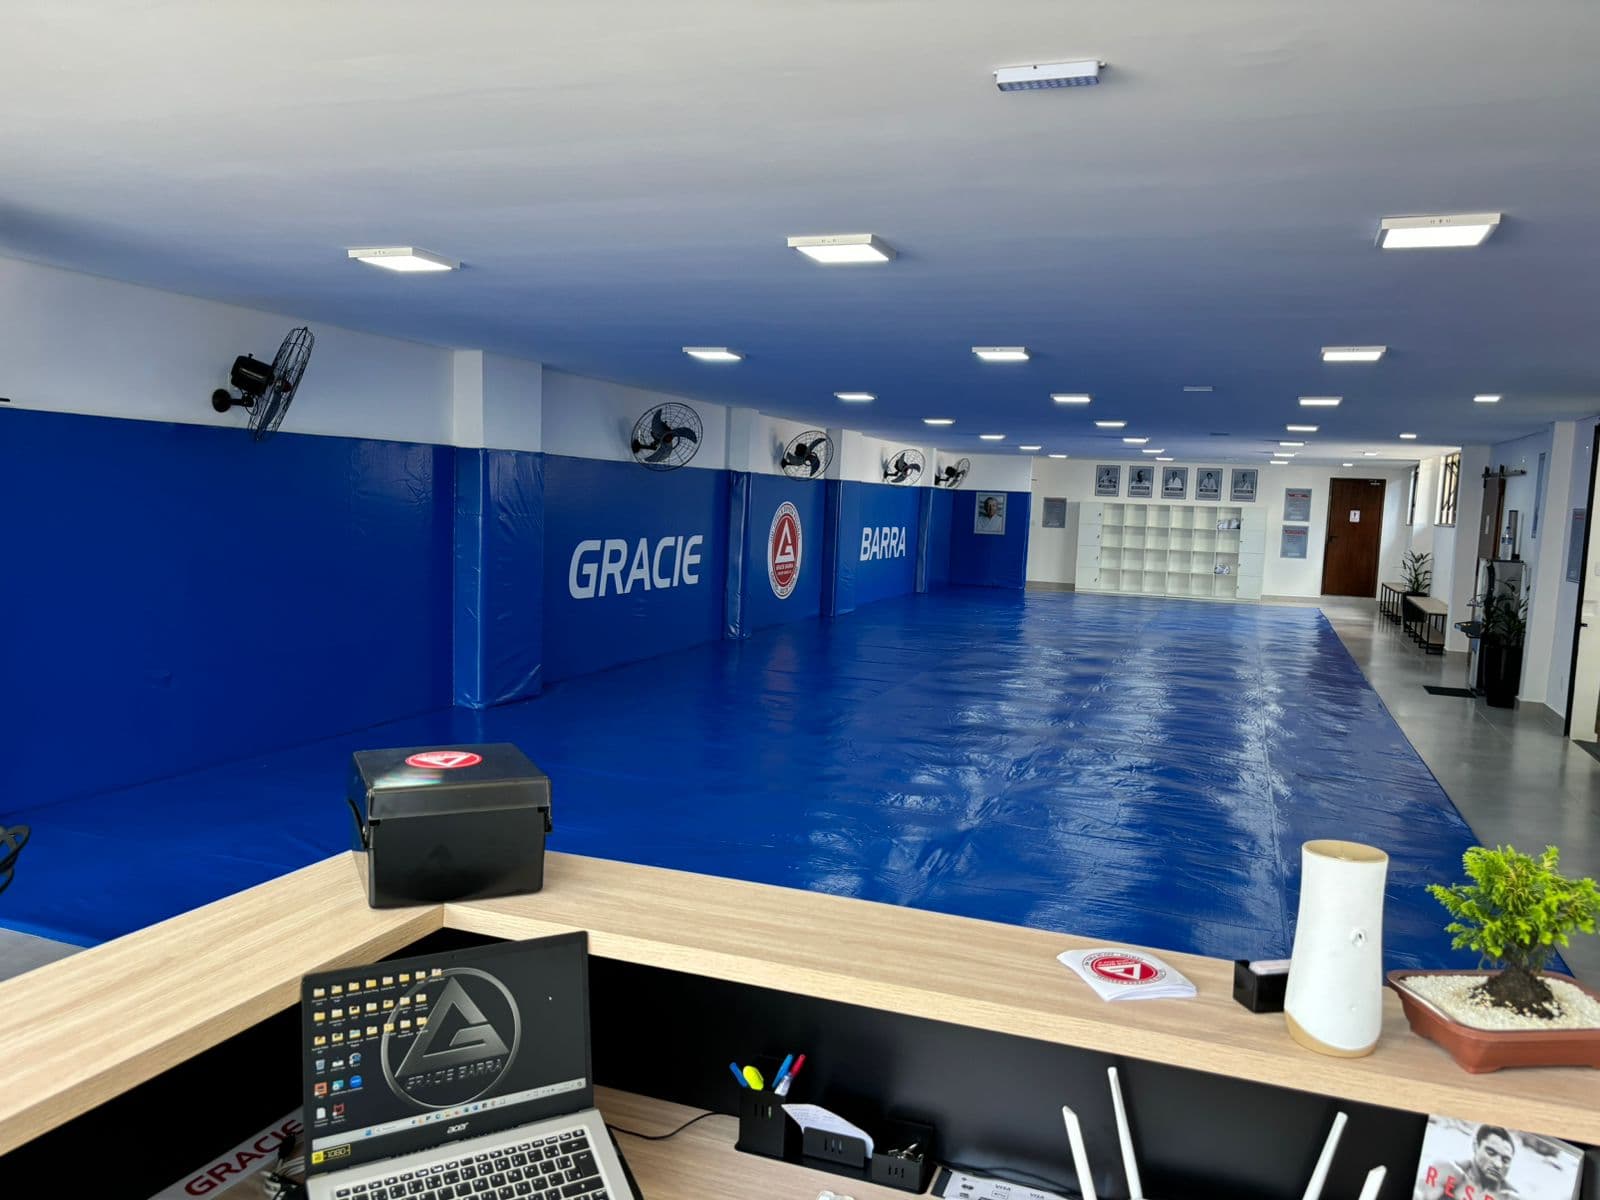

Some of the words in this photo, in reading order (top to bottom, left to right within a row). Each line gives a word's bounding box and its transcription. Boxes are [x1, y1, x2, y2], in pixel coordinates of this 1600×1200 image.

[859, 526, 907, 562] BARRA
[568, 534, 704, 600] GRACIE
[446, 1121, 470, 1135] acer
